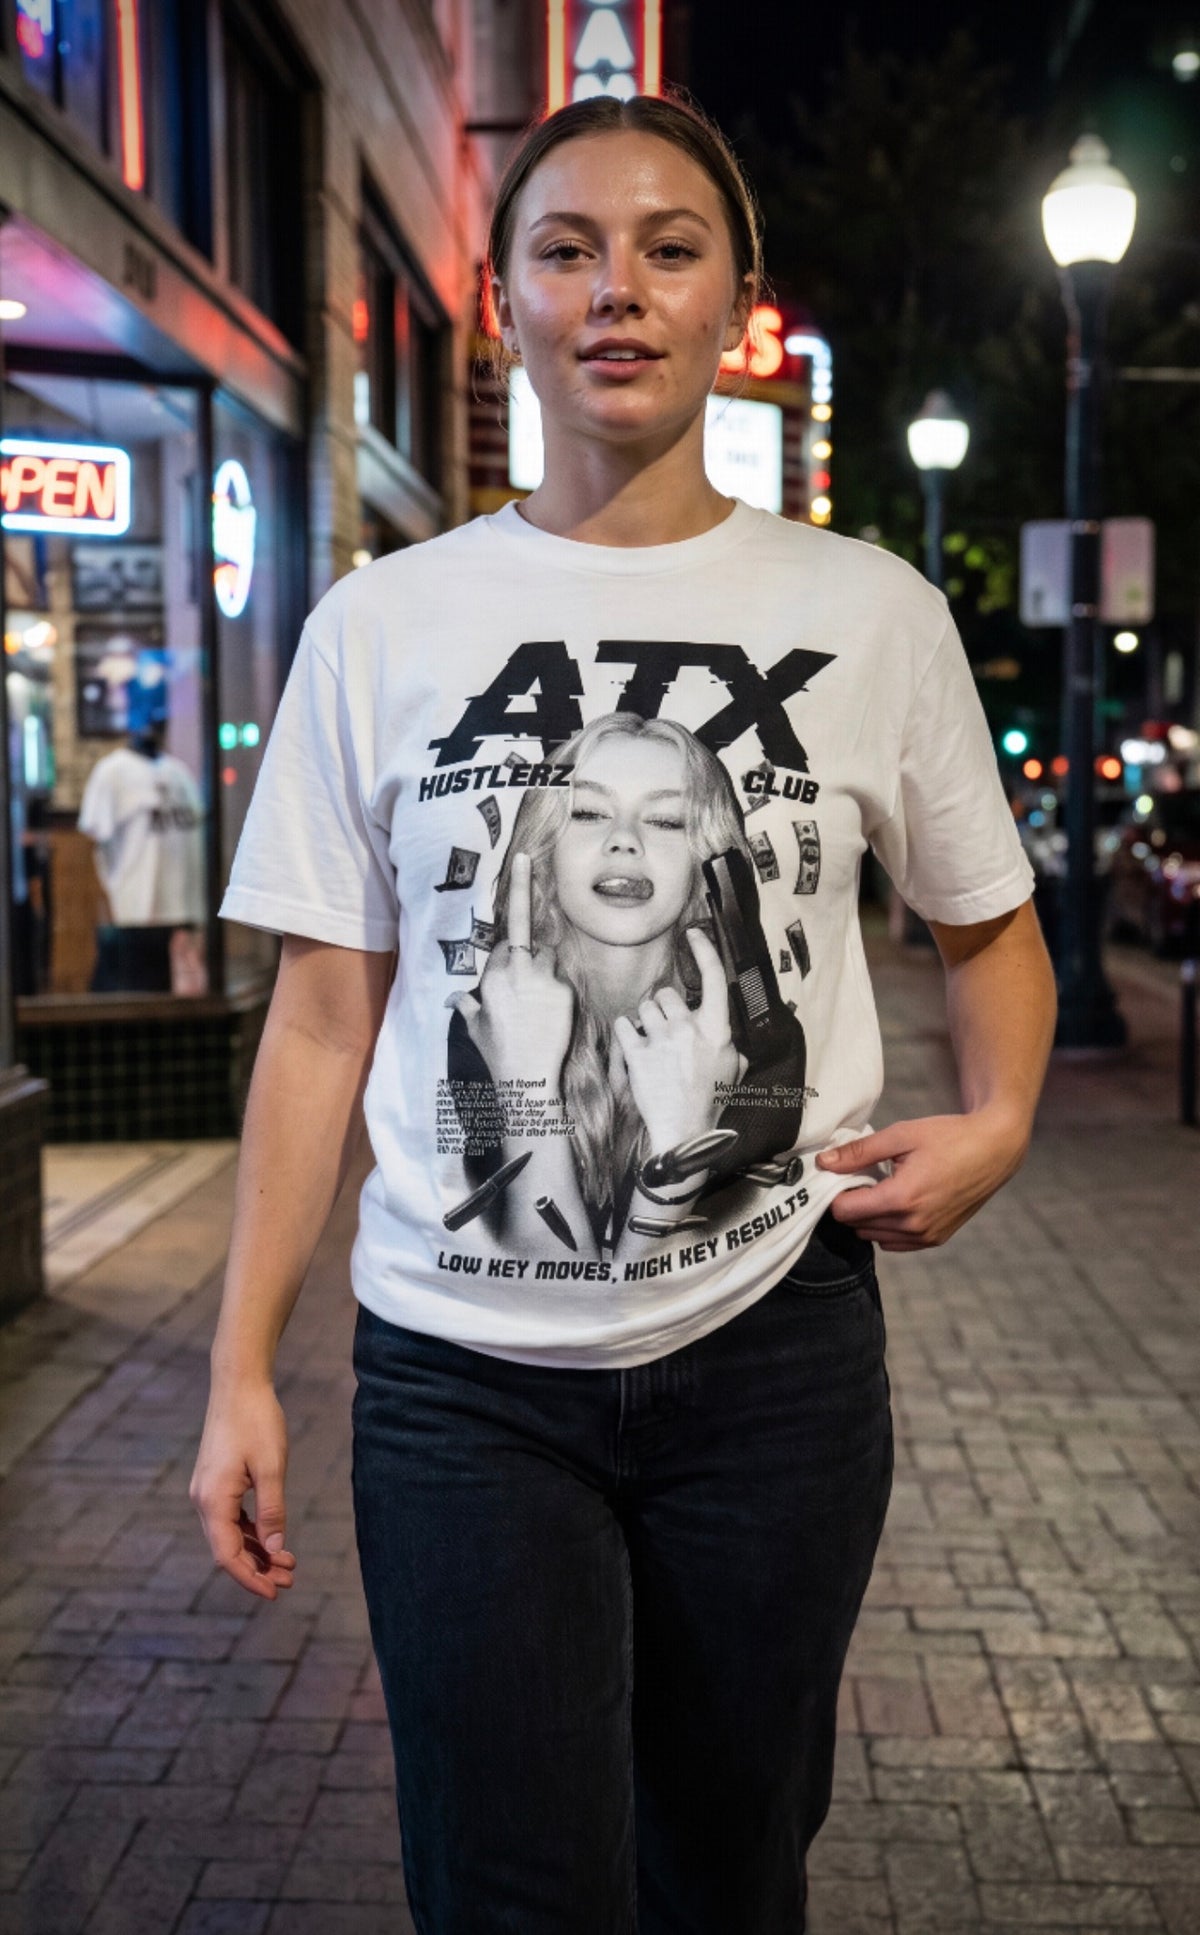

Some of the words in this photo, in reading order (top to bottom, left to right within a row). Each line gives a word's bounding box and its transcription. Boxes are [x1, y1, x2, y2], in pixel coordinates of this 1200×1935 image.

[427, 640, 838, 773] ATX
[418, 763, 576, 802] HUSTLERZ
[743, 770, 821, 804] CLUB
[437, 1252, 483, 1275] LOW
[488, 1259, 528, 1280] KEY
[536, 1260, 617, 1284] MOVES,
[624, 1252, 672, 1281] HIGH
[679, 1238, 719, 1269] KEY
[726, 1188, 809, 1251] RESULTS
